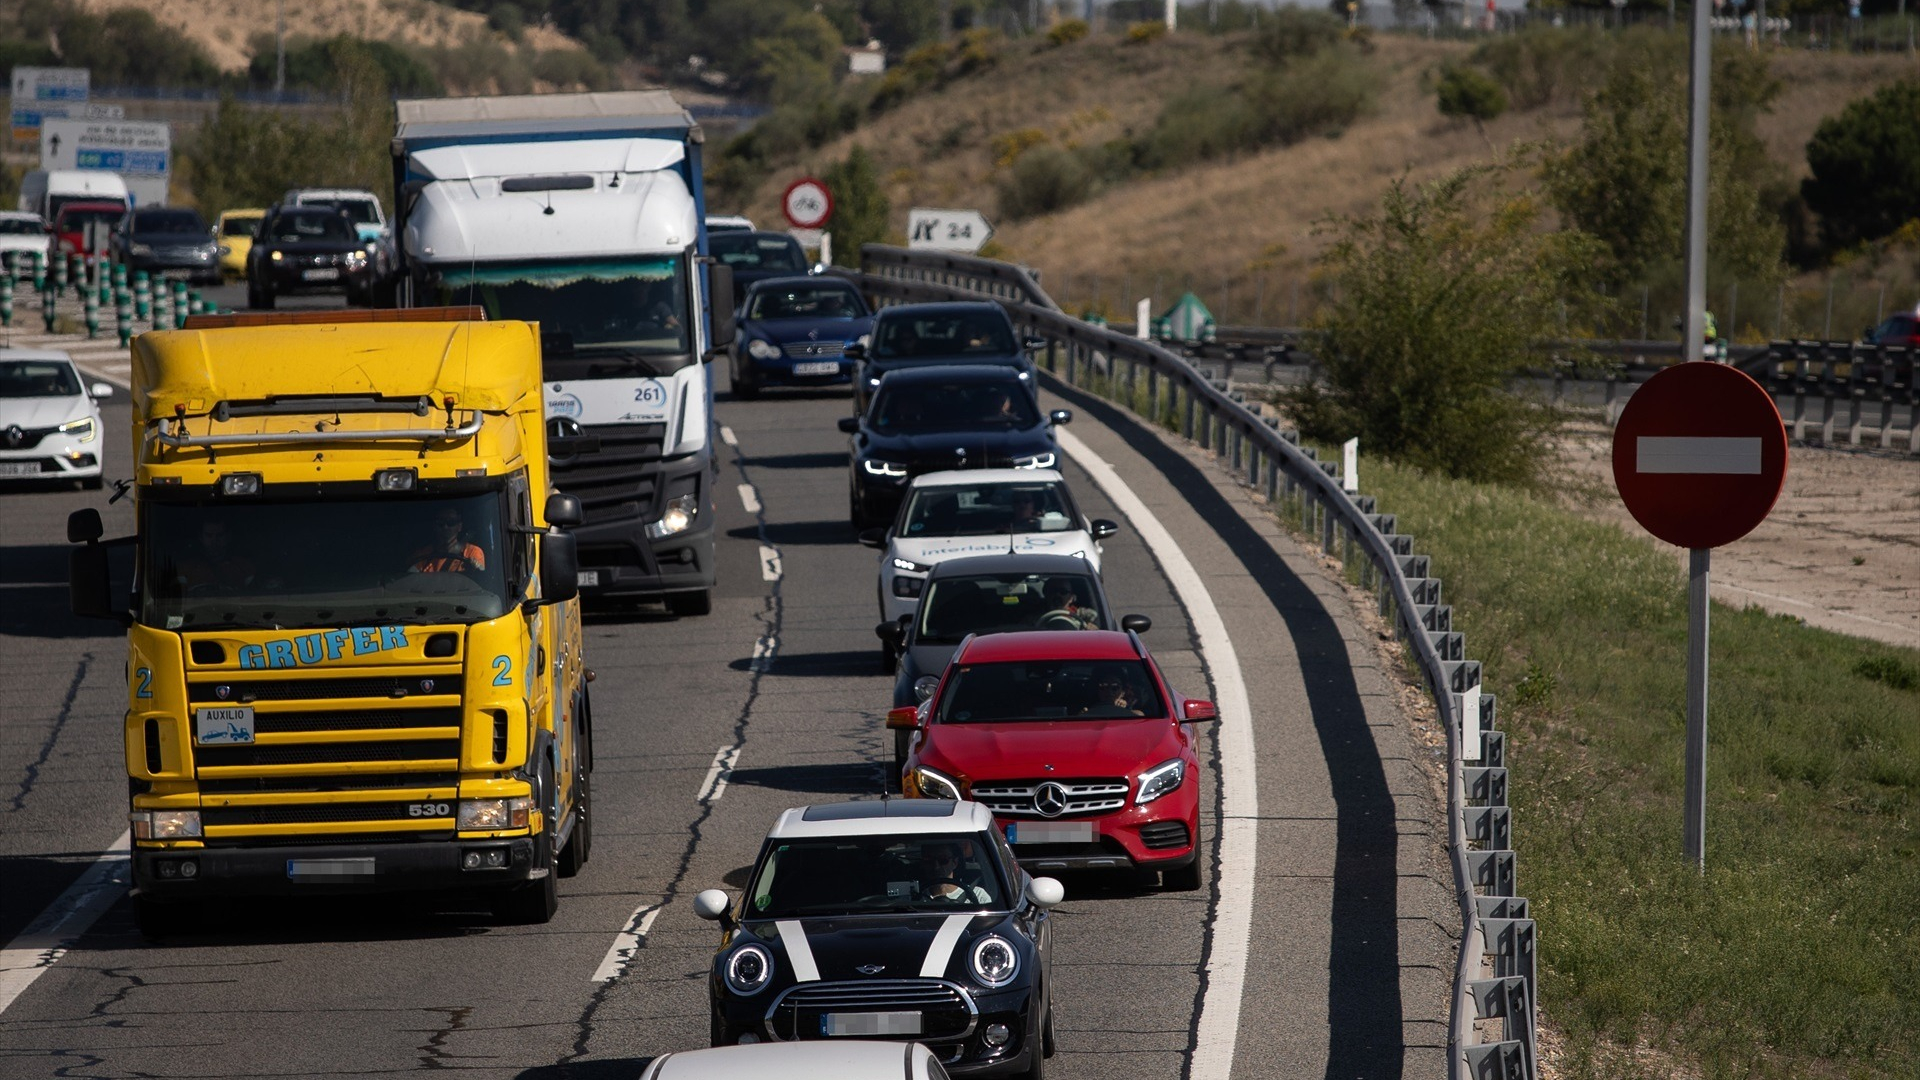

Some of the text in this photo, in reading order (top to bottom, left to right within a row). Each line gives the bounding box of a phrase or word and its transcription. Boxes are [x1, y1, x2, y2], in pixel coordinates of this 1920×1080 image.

[947, 222, 972, 240] 24
[634, 387, 659, 401] 261
[922, 544, 1033, 556] interlabora
[238, 626, 408, 669] GRUFER
[492, 655, 512, 686] 2
[136, 667, 153, 698] 2
[206, 708, 244, 721] AUXILIO
[408, 803, 450, 817] 530
